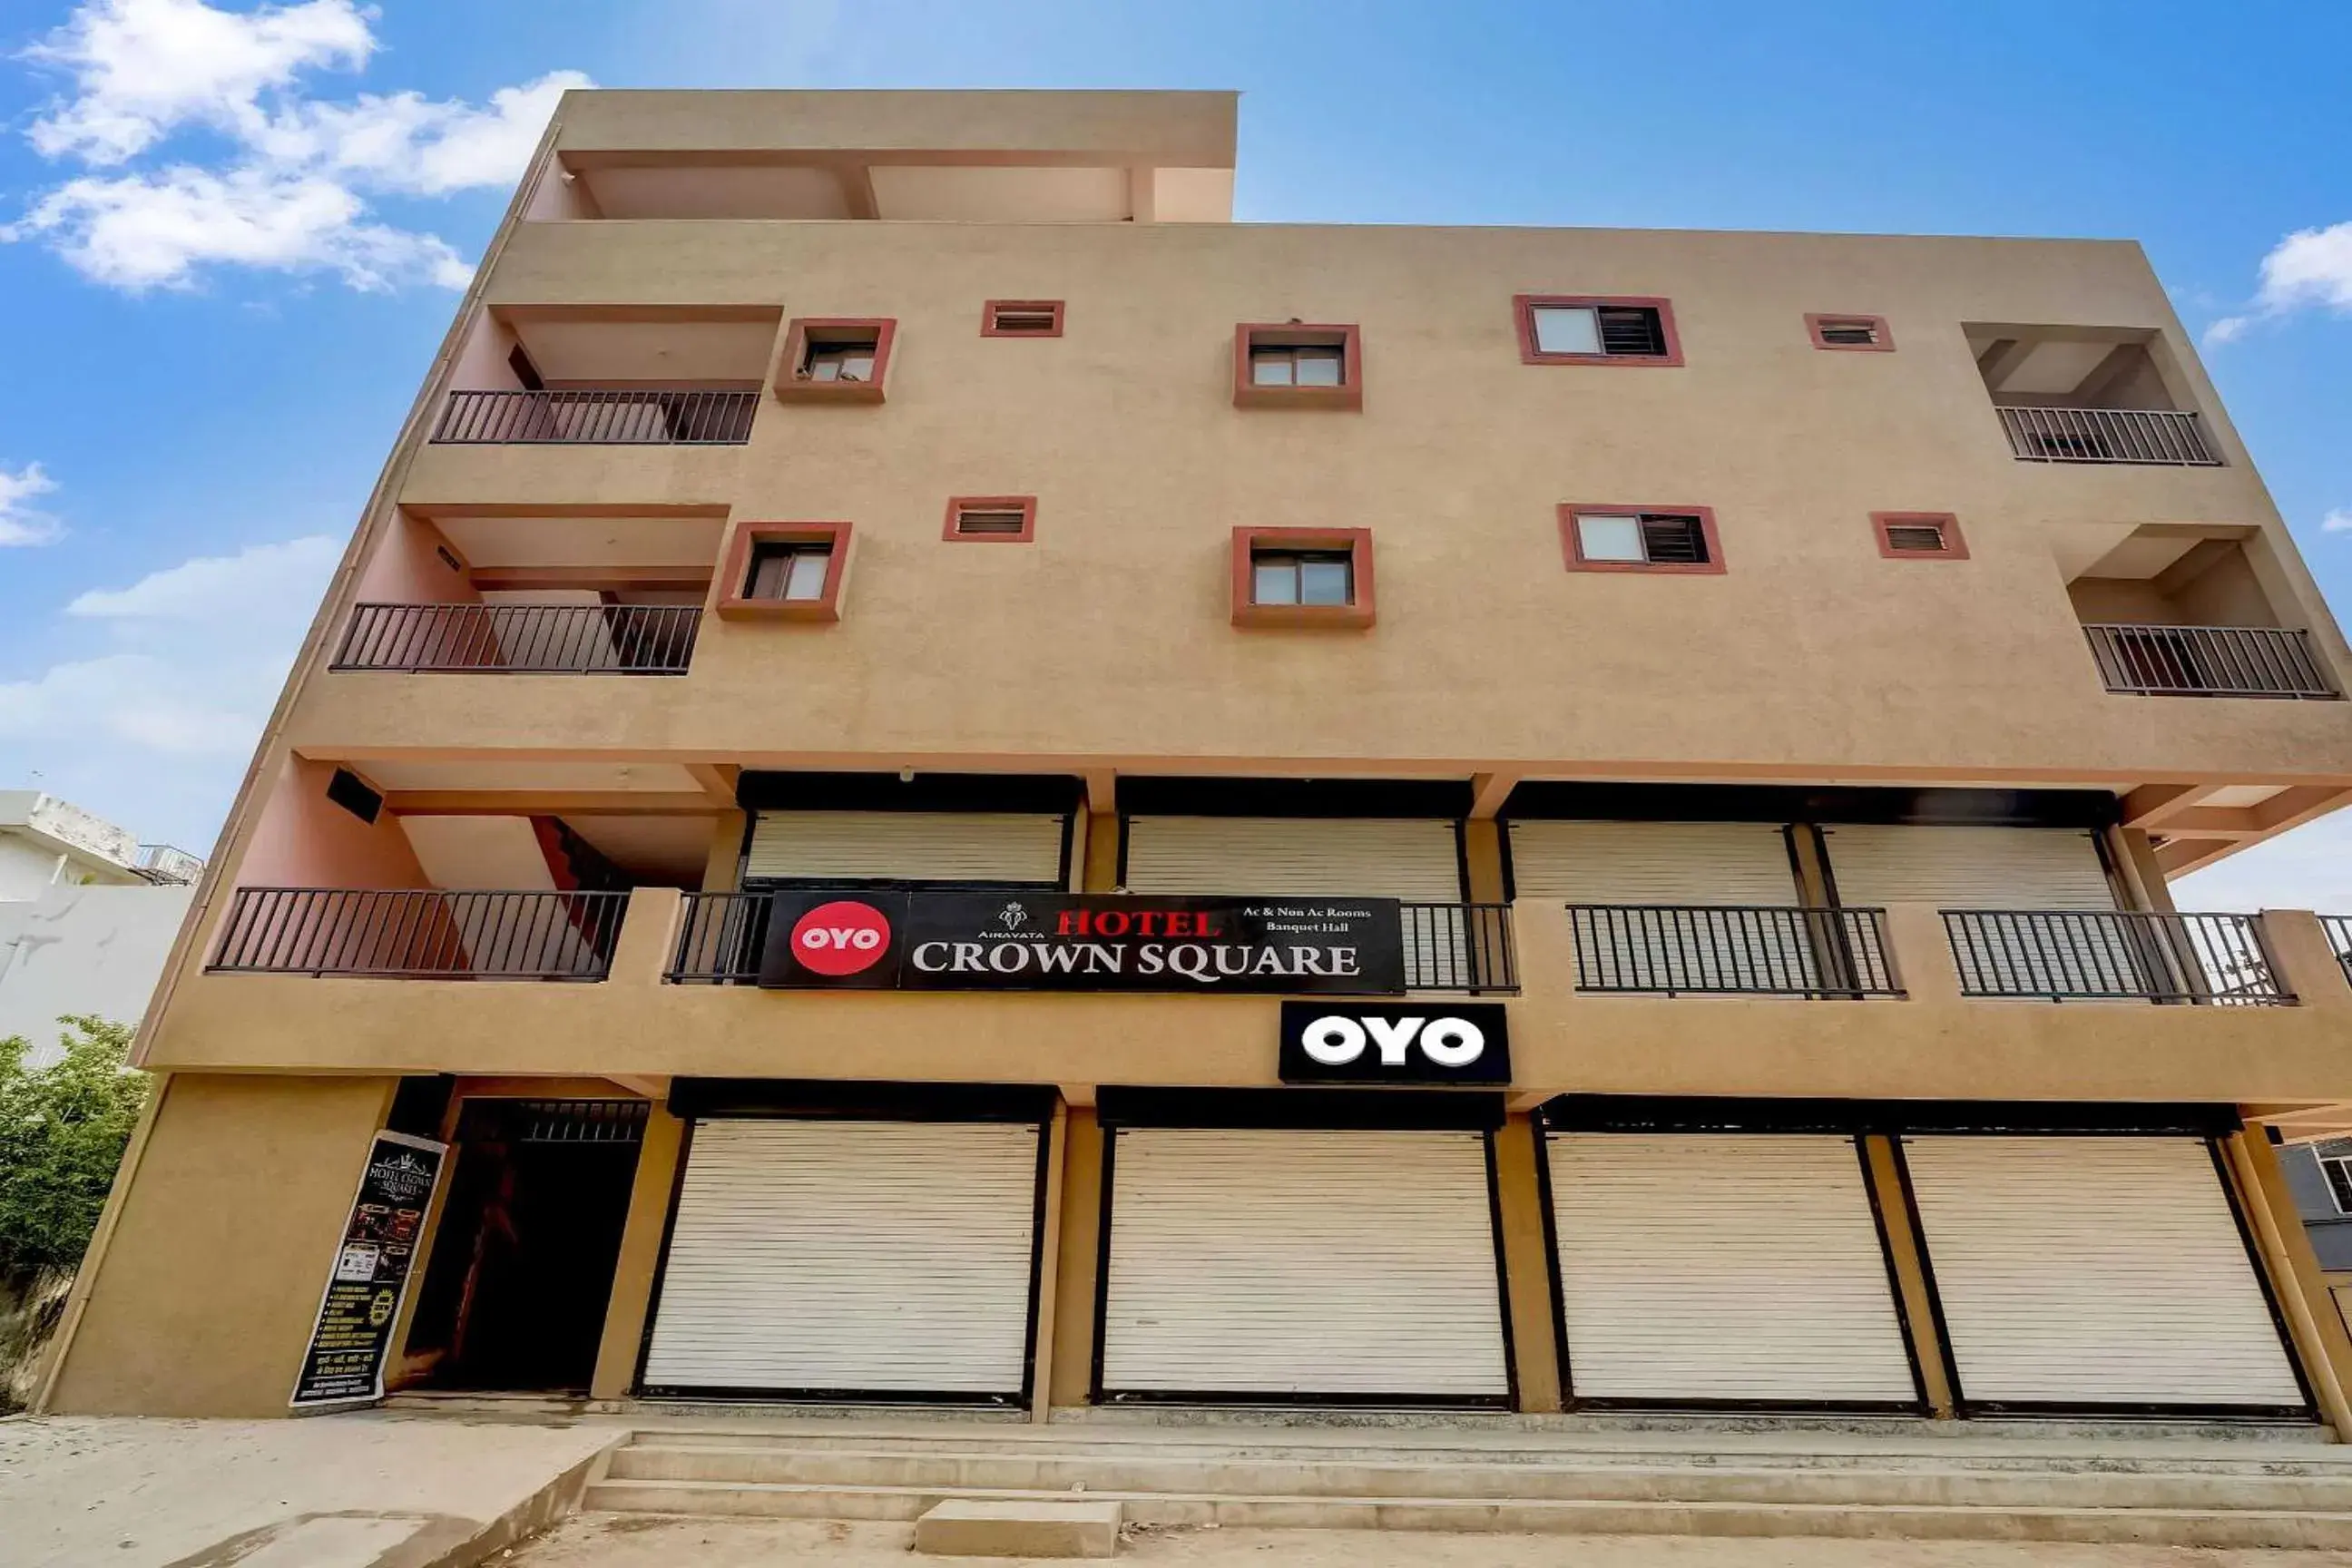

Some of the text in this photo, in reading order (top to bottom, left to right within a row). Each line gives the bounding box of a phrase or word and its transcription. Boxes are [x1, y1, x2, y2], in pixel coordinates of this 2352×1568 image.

[1054, 909, 1222, 937] HOTEL
[1327, 908, 1372, 918] Rooms
[801, 927, 881, 950] OYO
[1267, 922, 1349, 934] Banquet Hall
[912, 942, 1361, 983] CROWN SQUARE
[1301, 1015, 1485, 1068] OYO
